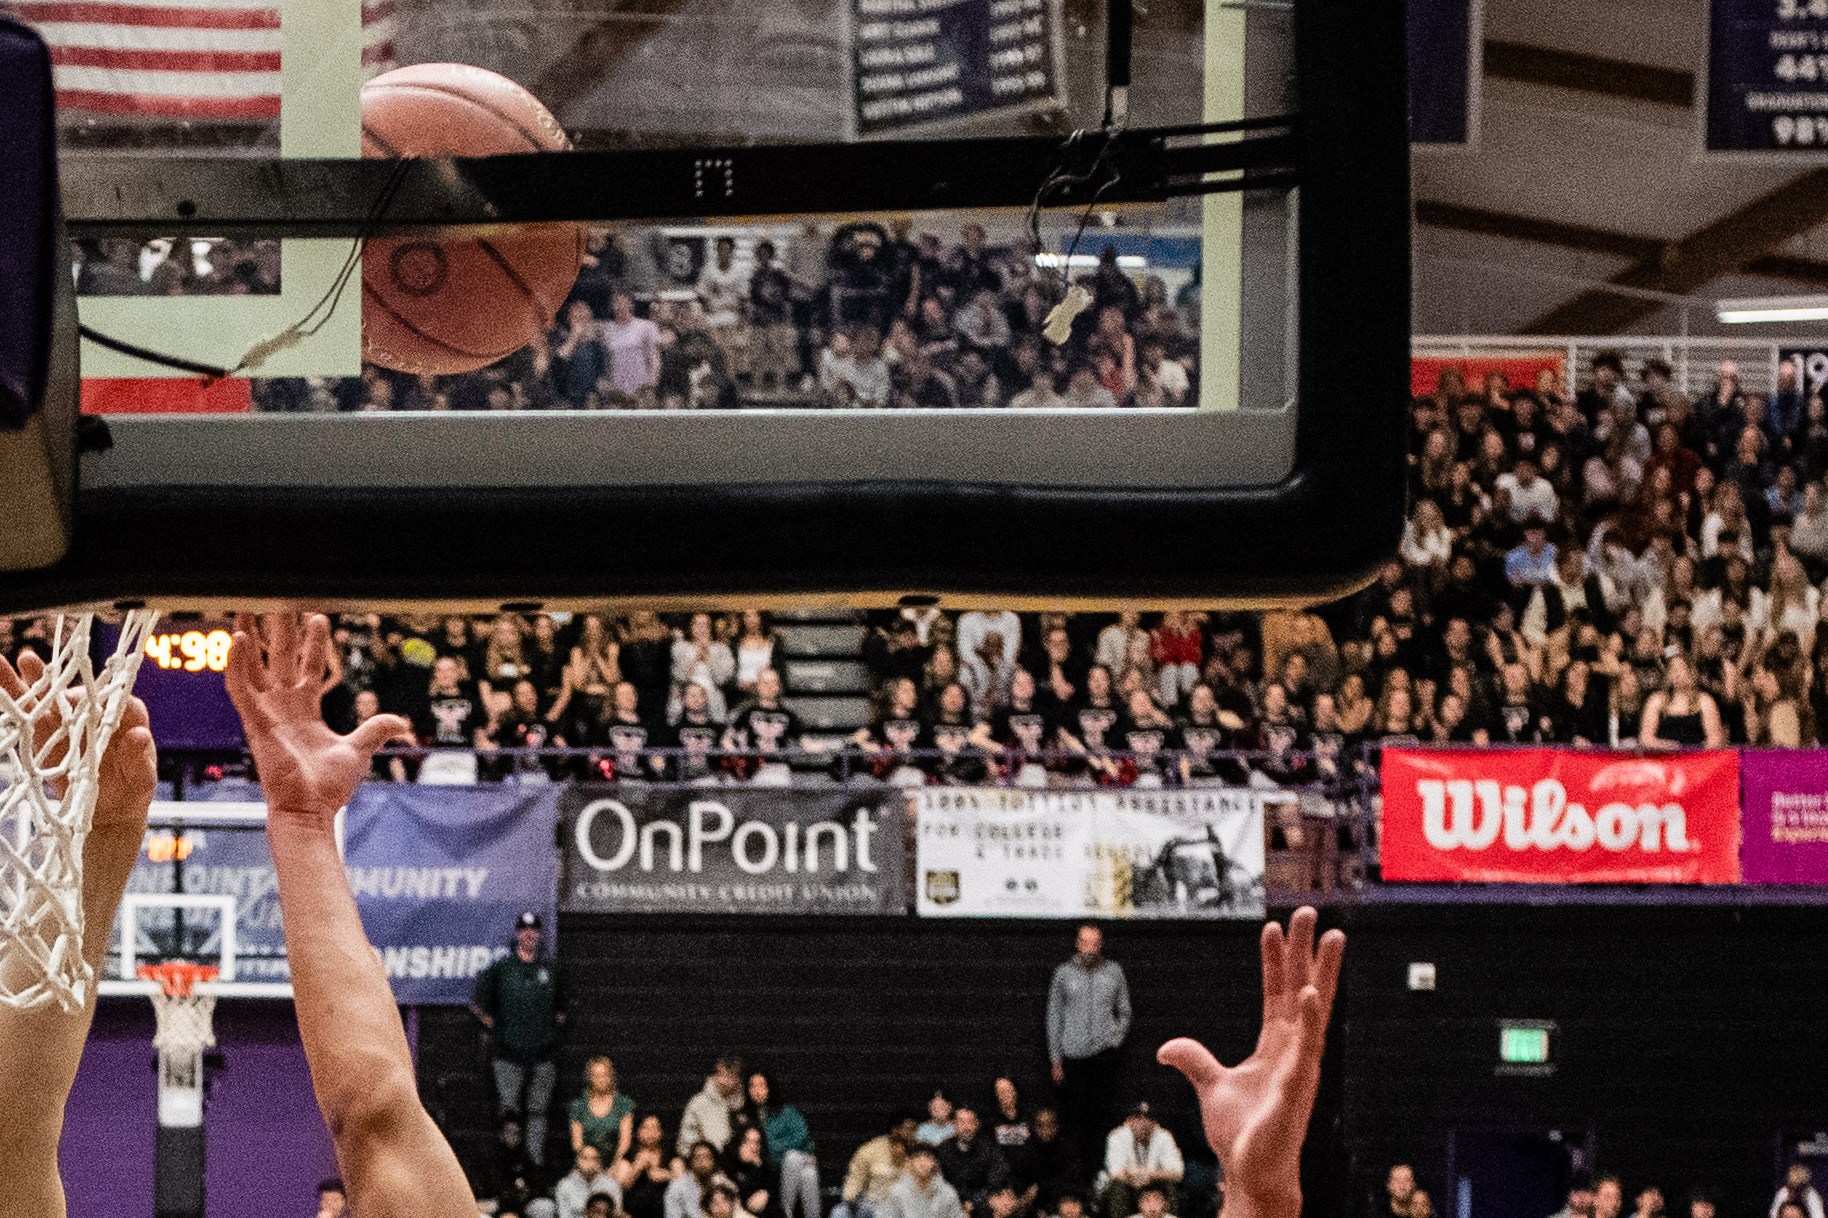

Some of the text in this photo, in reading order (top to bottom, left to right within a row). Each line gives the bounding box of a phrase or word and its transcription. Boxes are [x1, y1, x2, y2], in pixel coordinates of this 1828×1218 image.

[574, 799, 878, 874] OnPoint
[1417, 778, 1689, 851] Wilson
[346, 866, 489, 899] MUNITY
[576, 882, 878, 900] COMMUNITY CREDIT UNION
